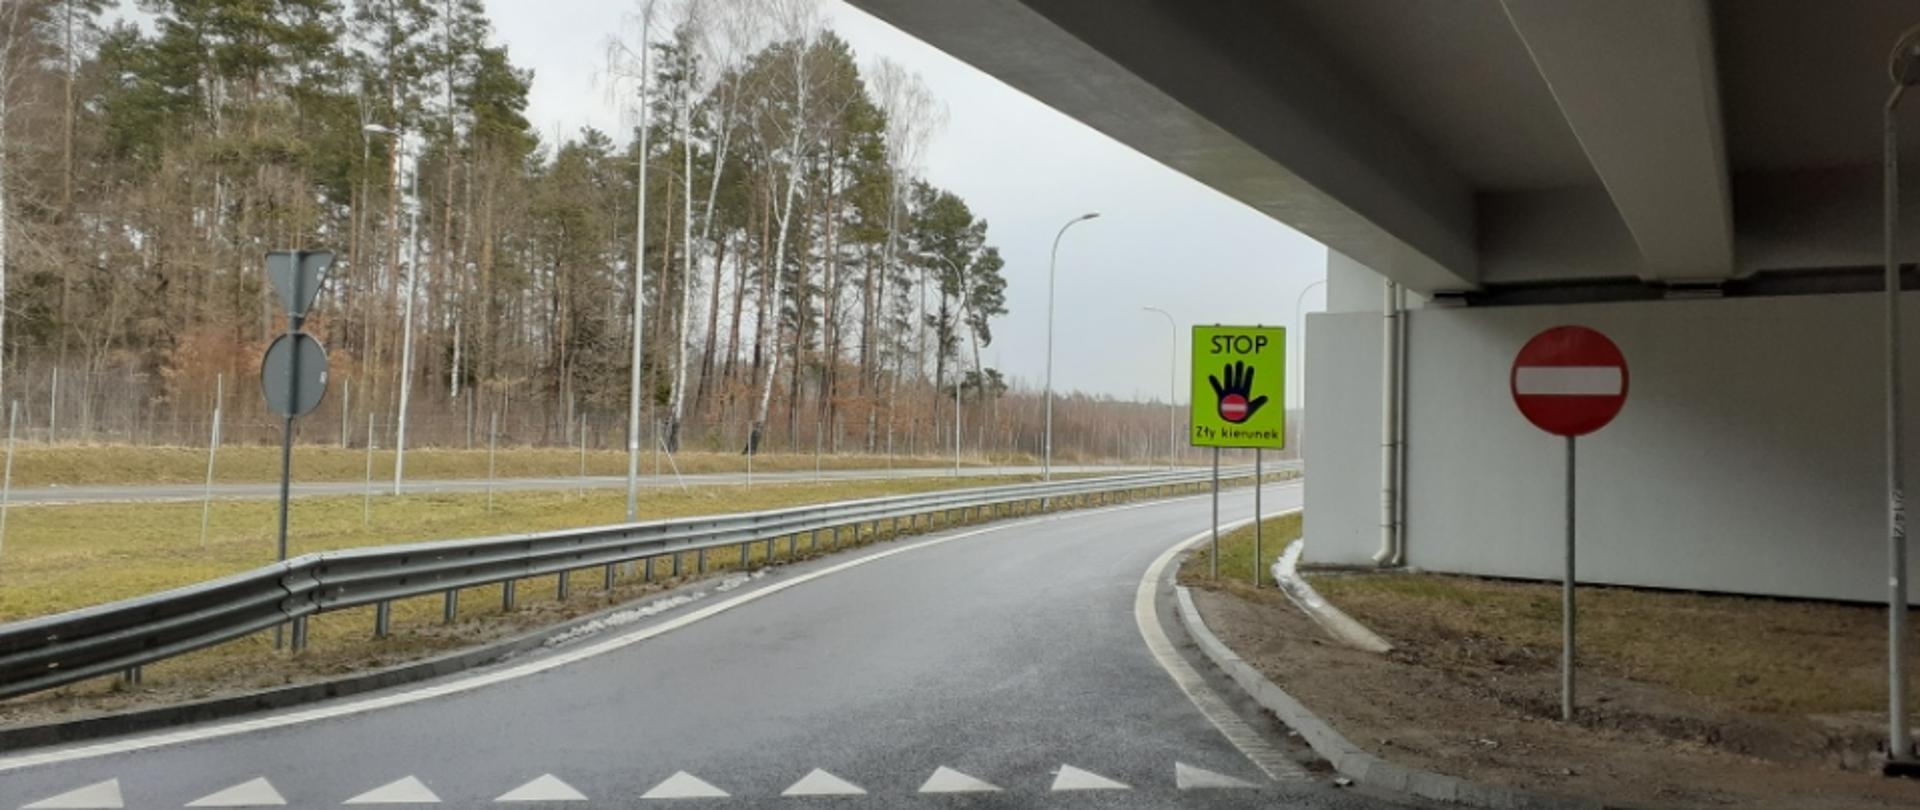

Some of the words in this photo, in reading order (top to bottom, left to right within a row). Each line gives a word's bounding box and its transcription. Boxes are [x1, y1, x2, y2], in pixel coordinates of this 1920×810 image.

[1210, 335, 1268, 354] STOP
[1196, 426, 1216, 440] Zły
[1221, 427, 1278, 439] kierunek
